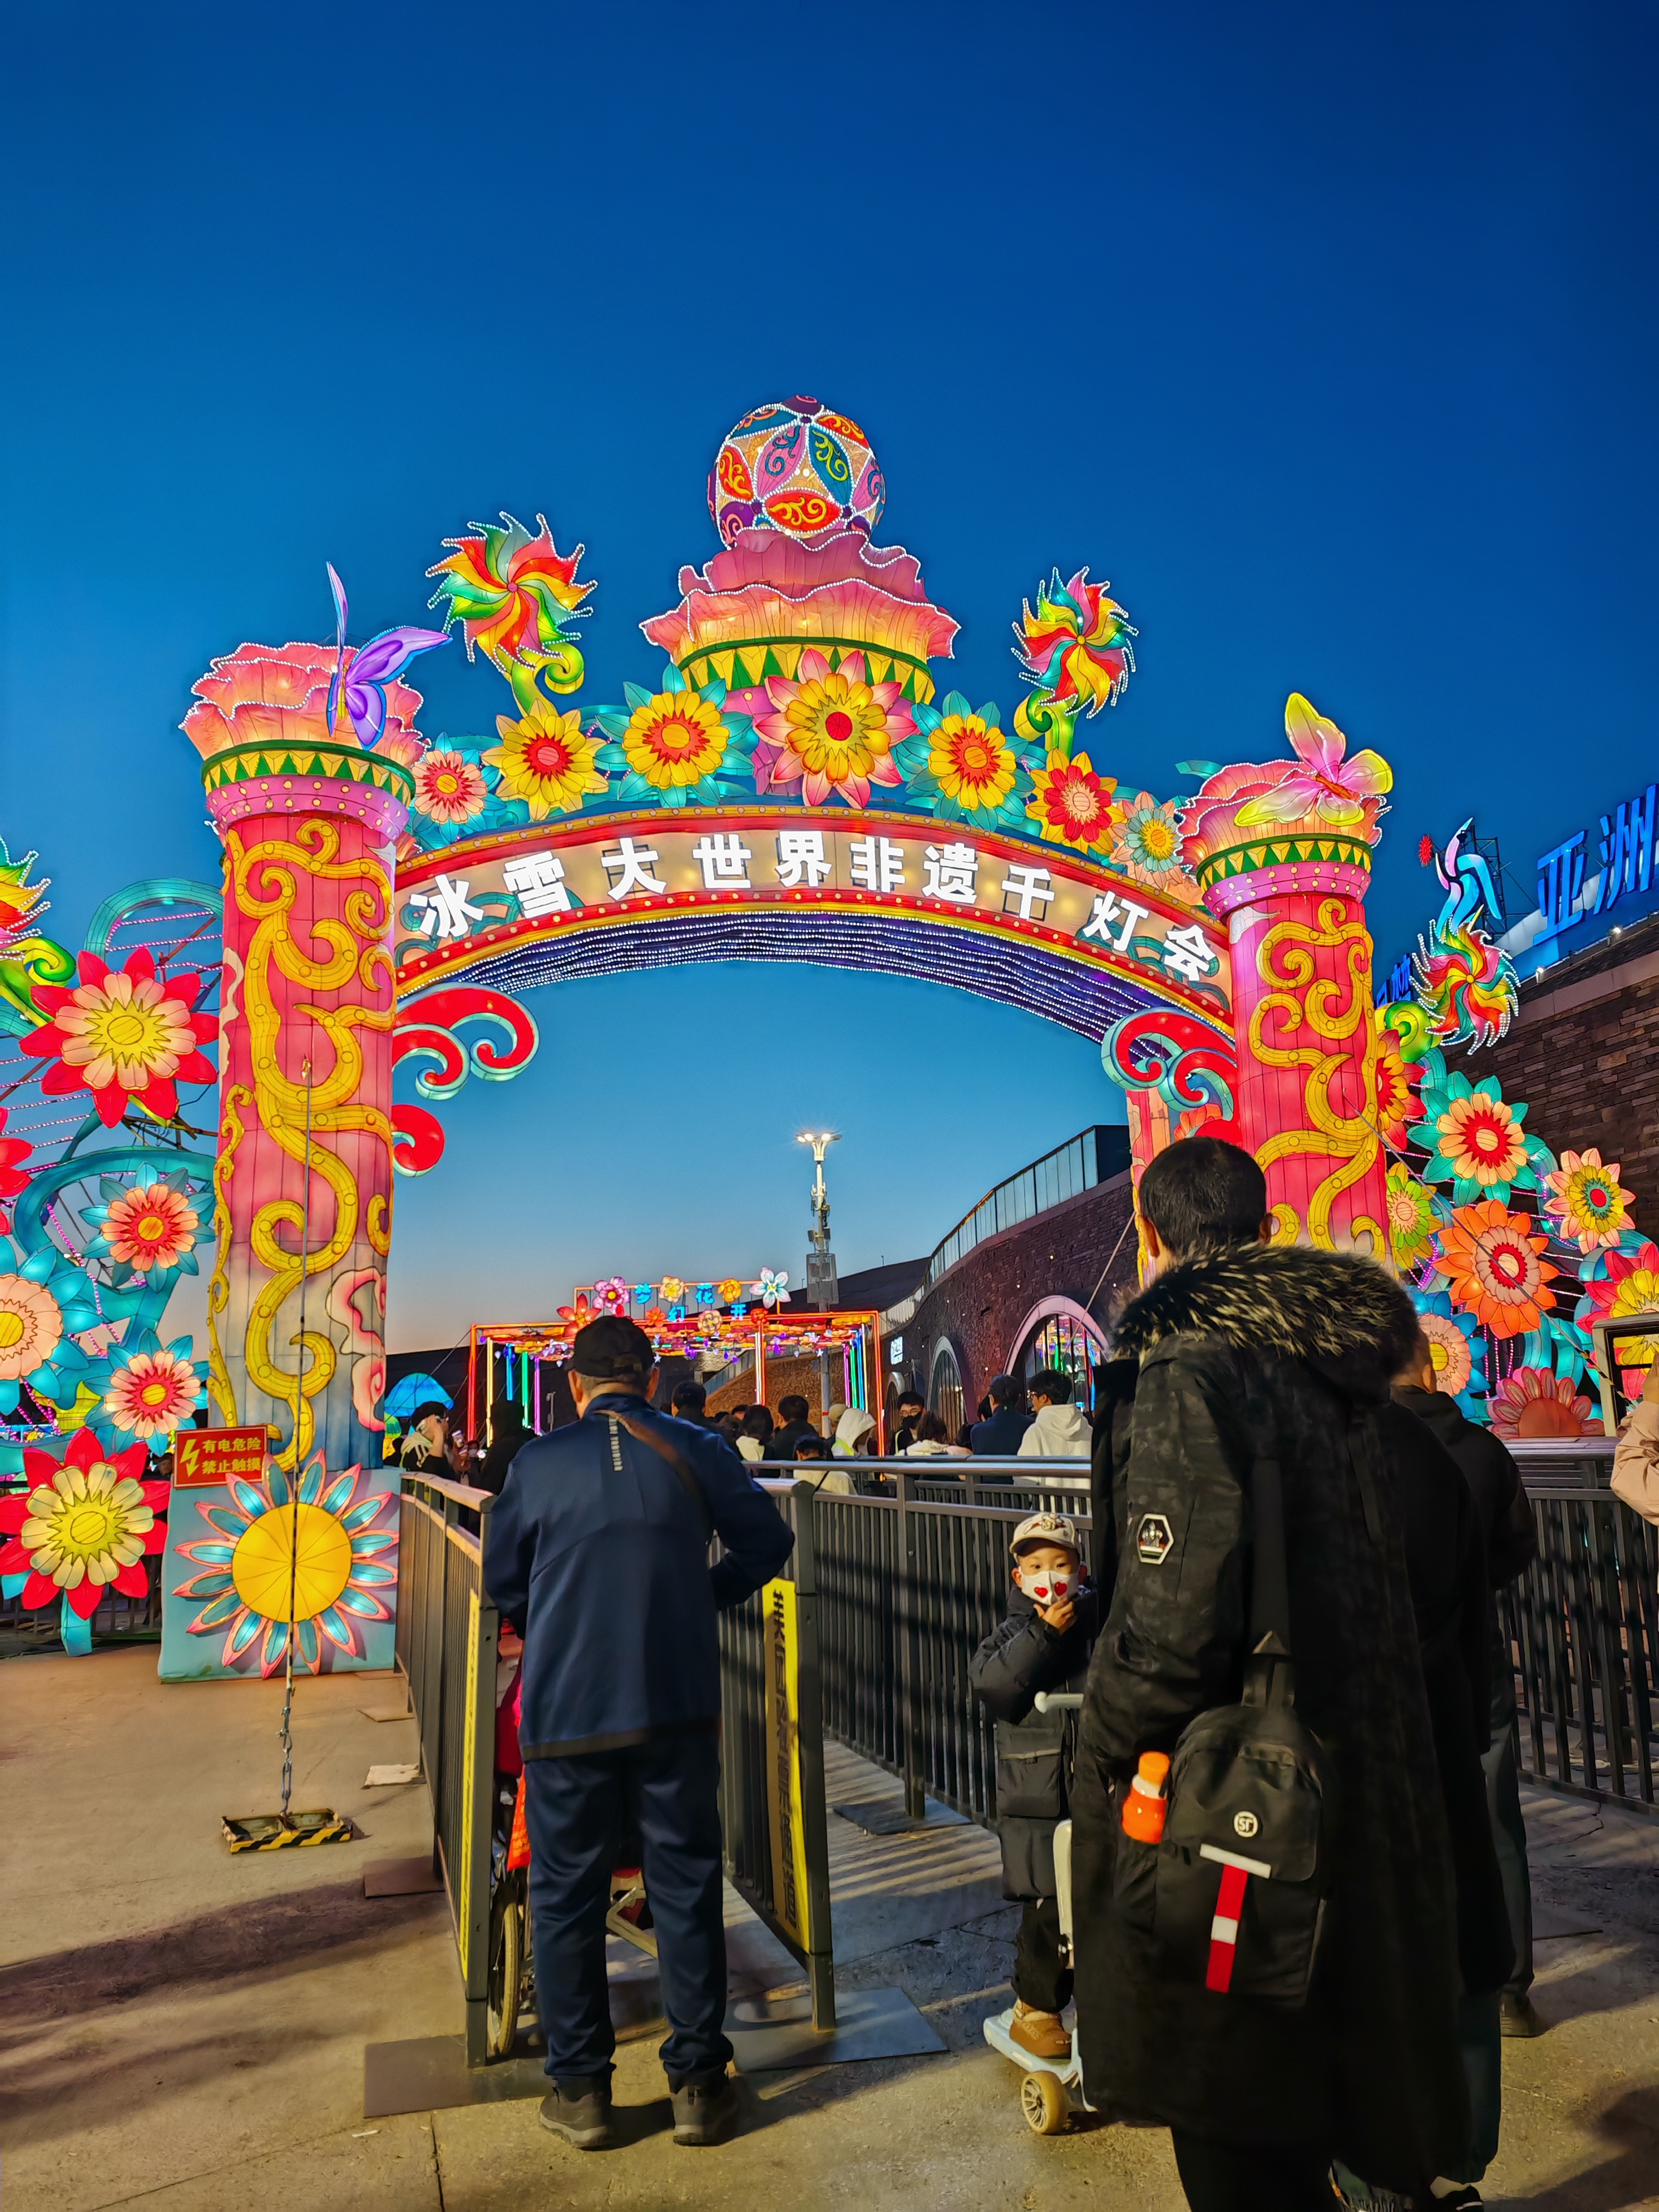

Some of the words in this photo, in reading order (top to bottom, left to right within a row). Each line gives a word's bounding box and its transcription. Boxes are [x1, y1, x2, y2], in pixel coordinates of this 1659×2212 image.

[410, 831, 1217, 982] 冰雪大世界非遗千灯会
[1533, 784, 1658, 946] 亚洲
[202, 1437, 261, 1453] 有电危险
[202, 1457, 261, 1474] 禁止触摸
